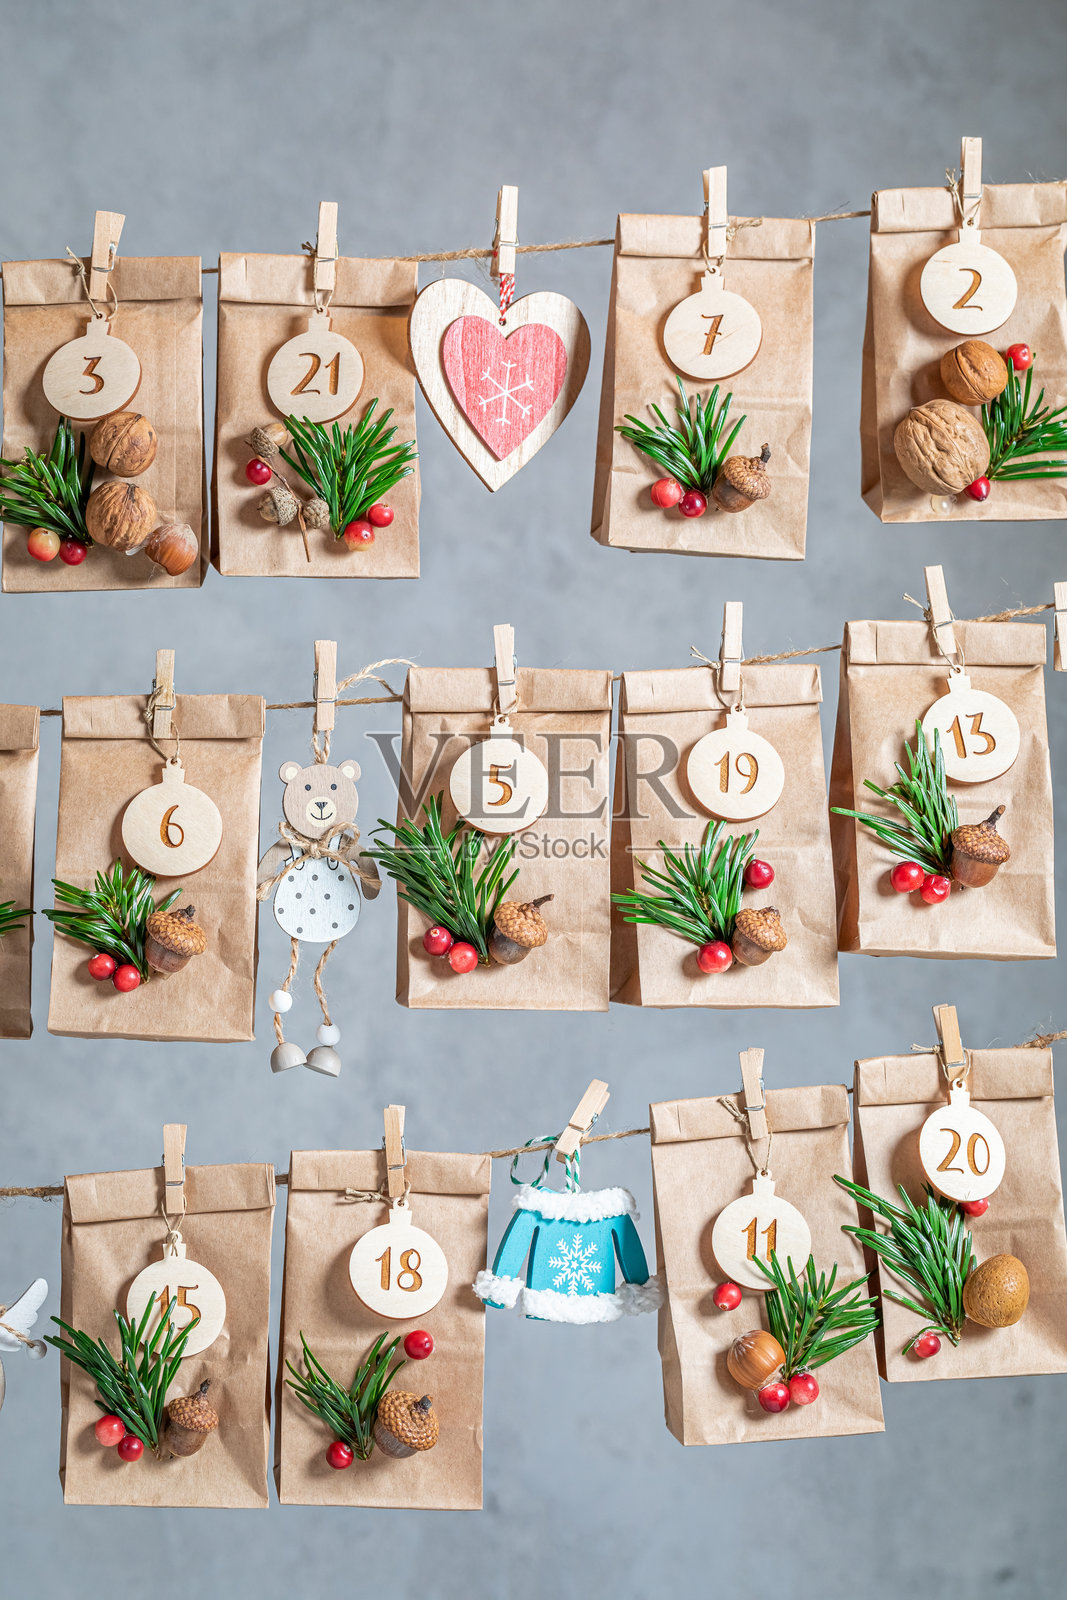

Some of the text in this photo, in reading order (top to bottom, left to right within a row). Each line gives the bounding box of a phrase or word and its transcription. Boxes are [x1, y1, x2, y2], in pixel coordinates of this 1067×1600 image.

[953, 268, 984, 312] 2
[700, 313, 724, 356] 7
[79, 355, 106, 396] 3
[290, 352, 341, 397] 21
[946, 712, 996, 759] 13
[487, 763, 513, 807] 5
[714, 751, 760, 796] 19
[159, 804, 186, 849] 6
[936, 1127, 991, 1177] 20
[741, 1216, 778, 1263] 11
[374, 1245, 424, 1293] 18
[153, 1284, 202, 1332] 15
